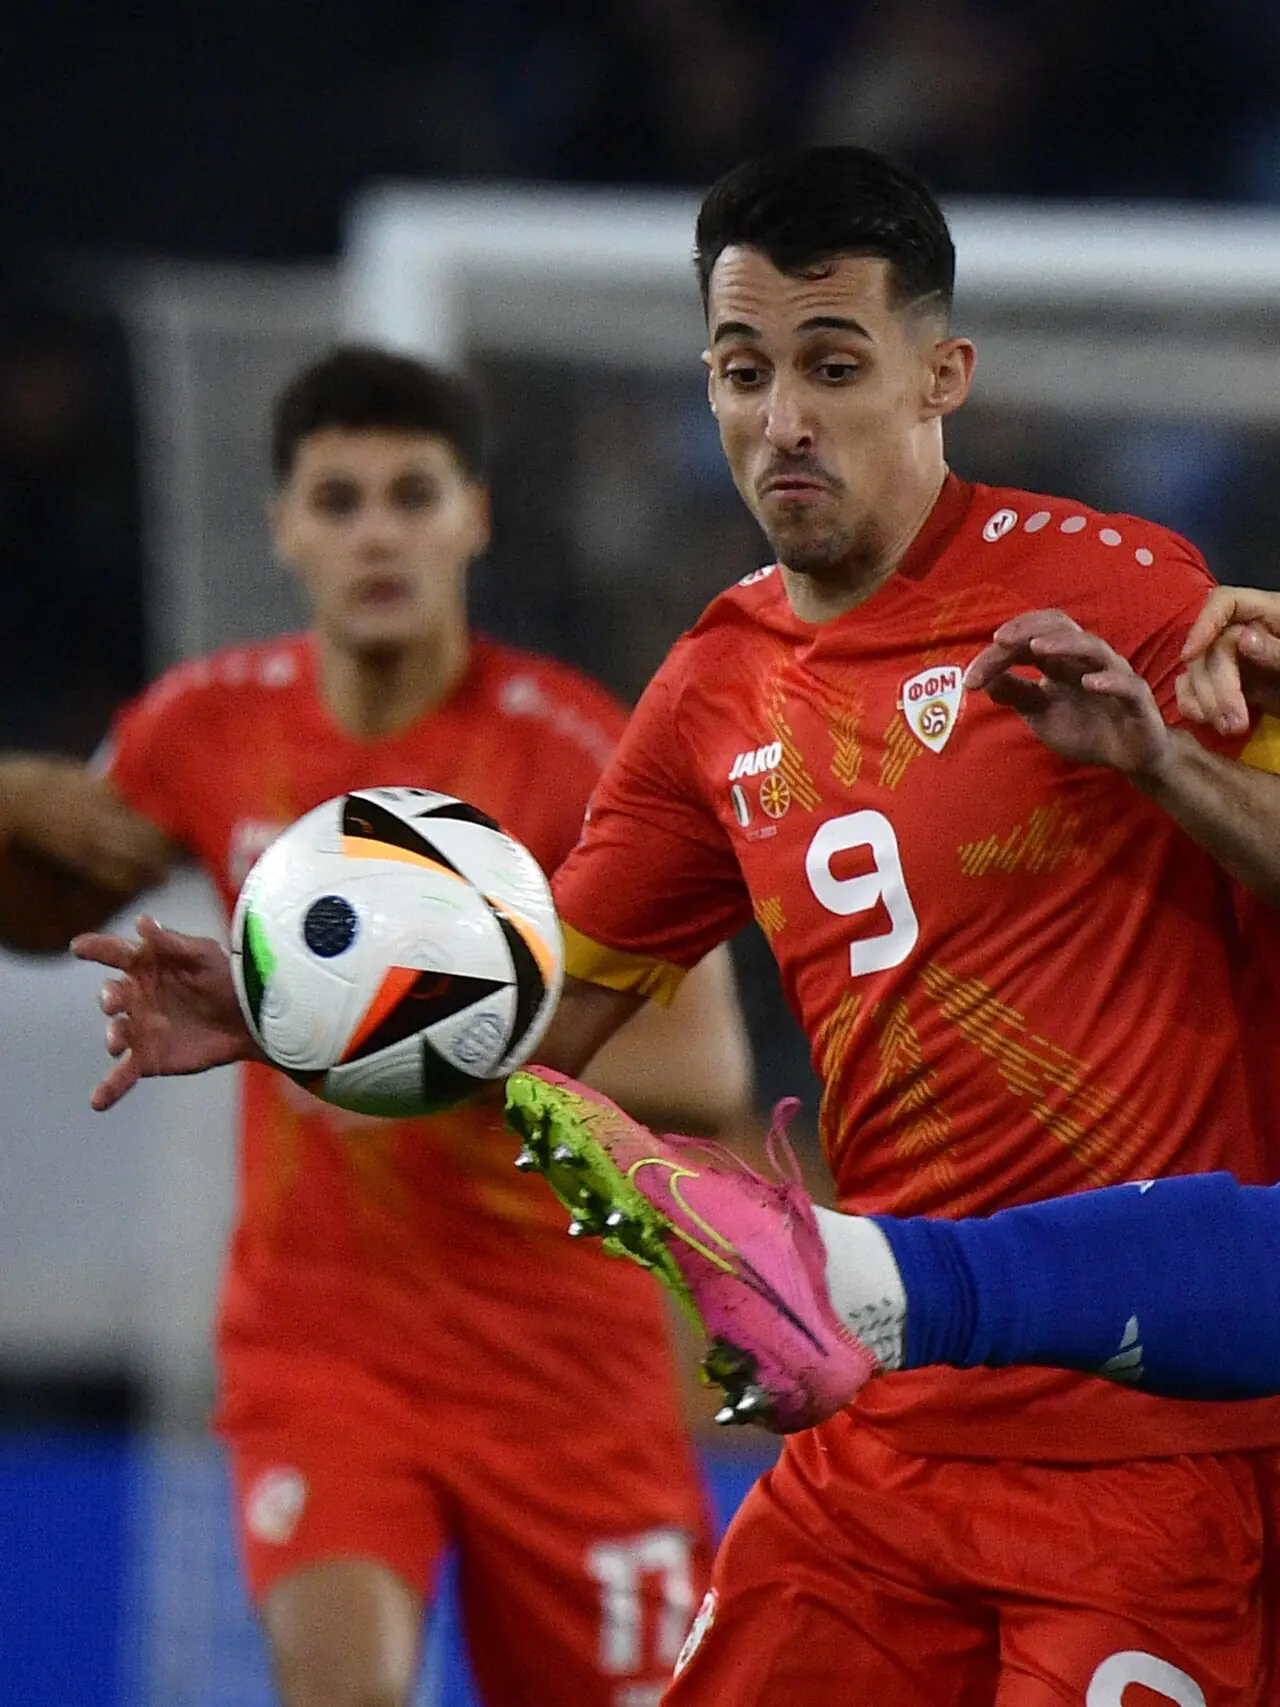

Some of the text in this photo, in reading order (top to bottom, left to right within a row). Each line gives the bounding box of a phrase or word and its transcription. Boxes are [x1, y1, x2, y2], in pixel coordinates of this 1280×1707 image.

[907, 670, 958, 702] ФФМ
[728, 740, 783, 782] JAKO
[805, 809, 920, 978] 9
